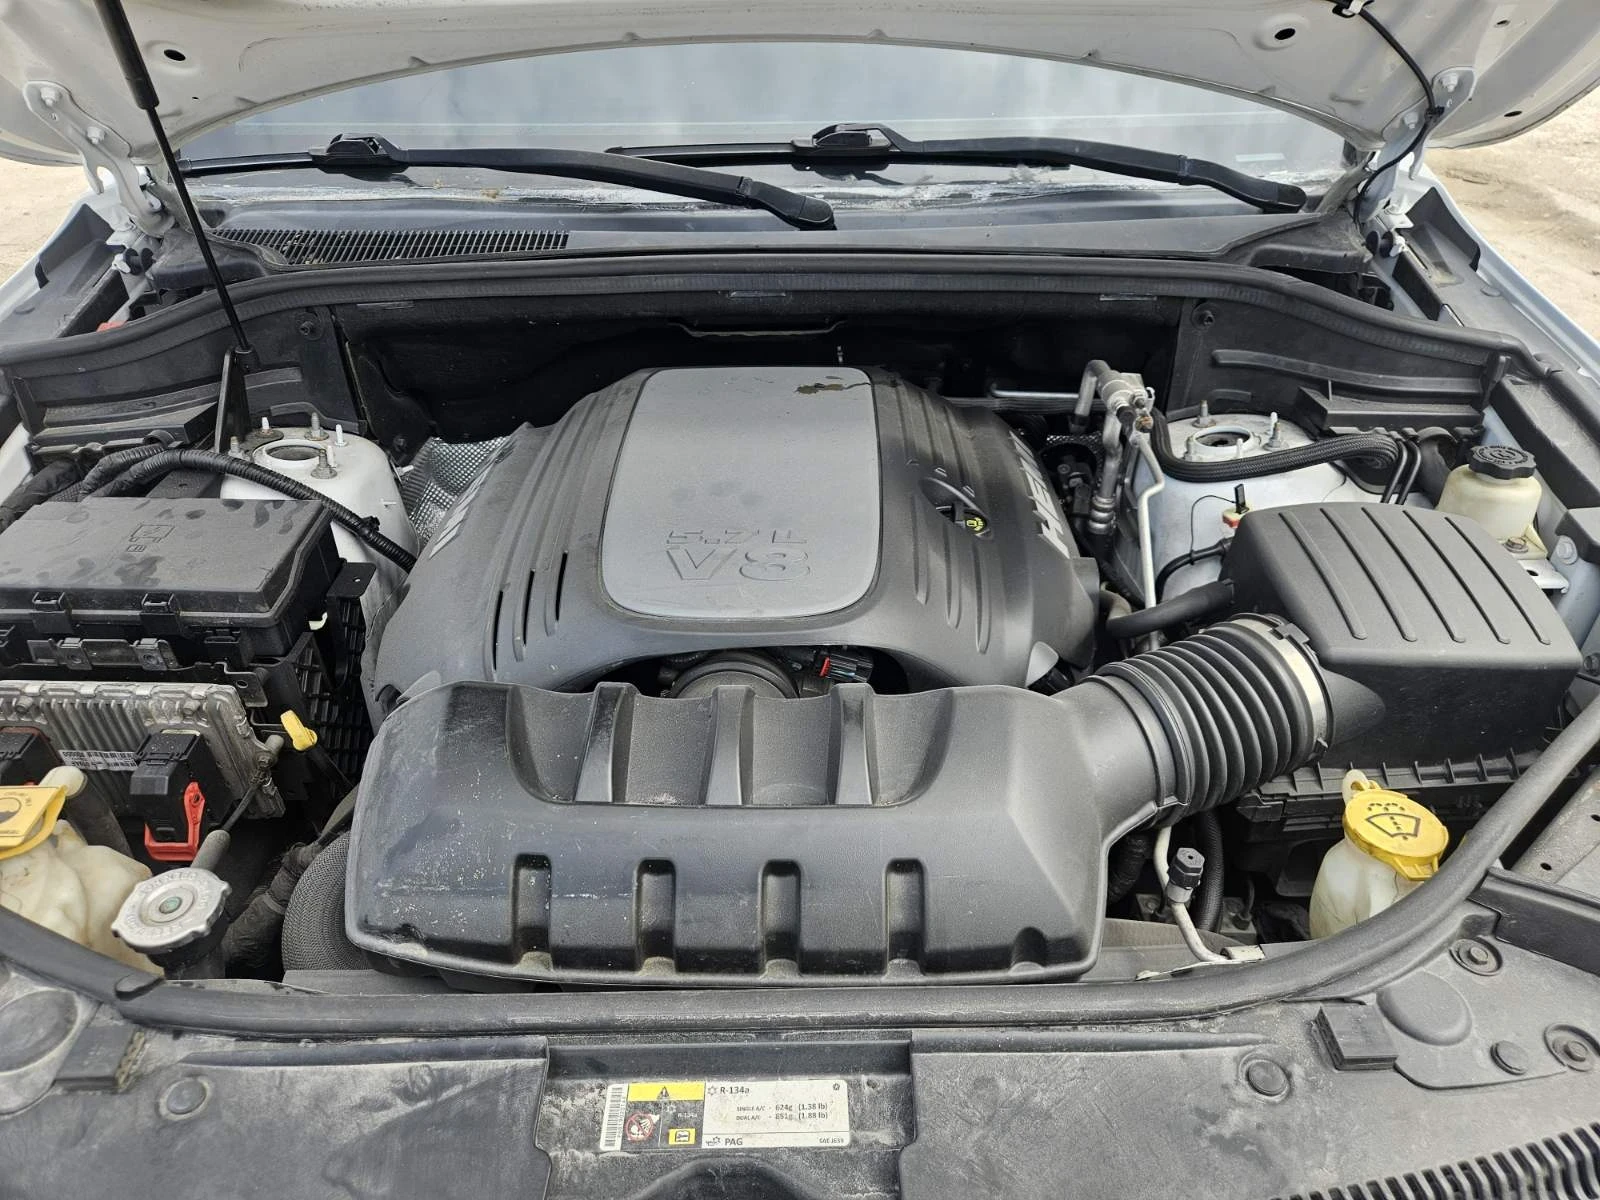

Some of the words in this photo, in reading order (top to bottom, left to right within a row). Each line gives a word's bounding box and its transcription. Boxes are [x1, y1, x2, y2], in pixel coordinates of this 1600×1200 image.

[666, 529, 808, 545] 5.7L
[665, 547, 811, 582] V8
[720, 1086, 750, 1095] R-134a
[818, 1102, 828, 1110] lb)
[818, 1111, 829, 1119] lb)
[724, 1137, 744, 1146] PAG
